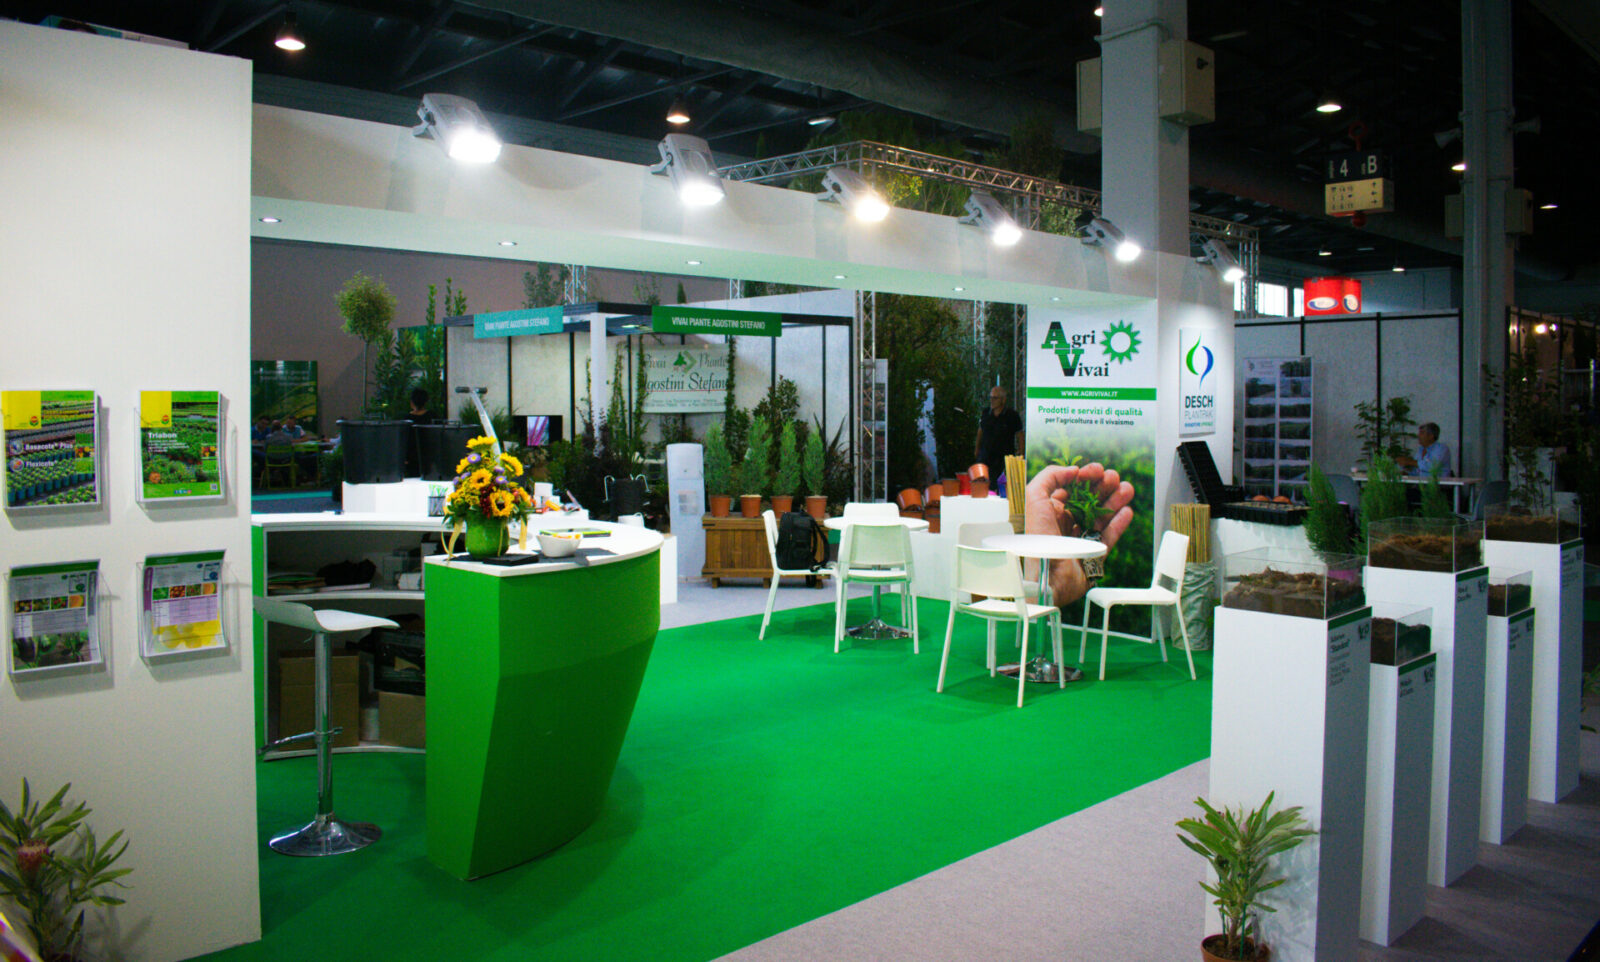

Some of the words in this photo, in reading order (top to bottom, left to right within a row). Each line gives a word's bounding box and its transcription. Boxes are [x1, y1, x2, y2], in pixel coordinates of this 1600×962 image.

[1340, 159, 1348, 176] 4
[1368, 155, 1377, 174] B
[672, 317, 688, 326] VIVAI
[689, 318, 711, 327] PIANTE
[712, 318, 739, 328] AGOSTINI
[740, 320, 765, 329] STEFANO
[1041, 321, 1096, 349] Agri
[1054, 348, 1110, 377] Vivai
[1060, 390, 1118, 398] WWW.AGRIVIVAI.IT
[1185, 395, 1213, 409] DESCH
[1038, 405, 1070, 415] Prodotti
[1077, 406, 1103, 416] servizi
[1105, 407, 1113, 416] di
[1114, 407, 1143, 418] qualità
